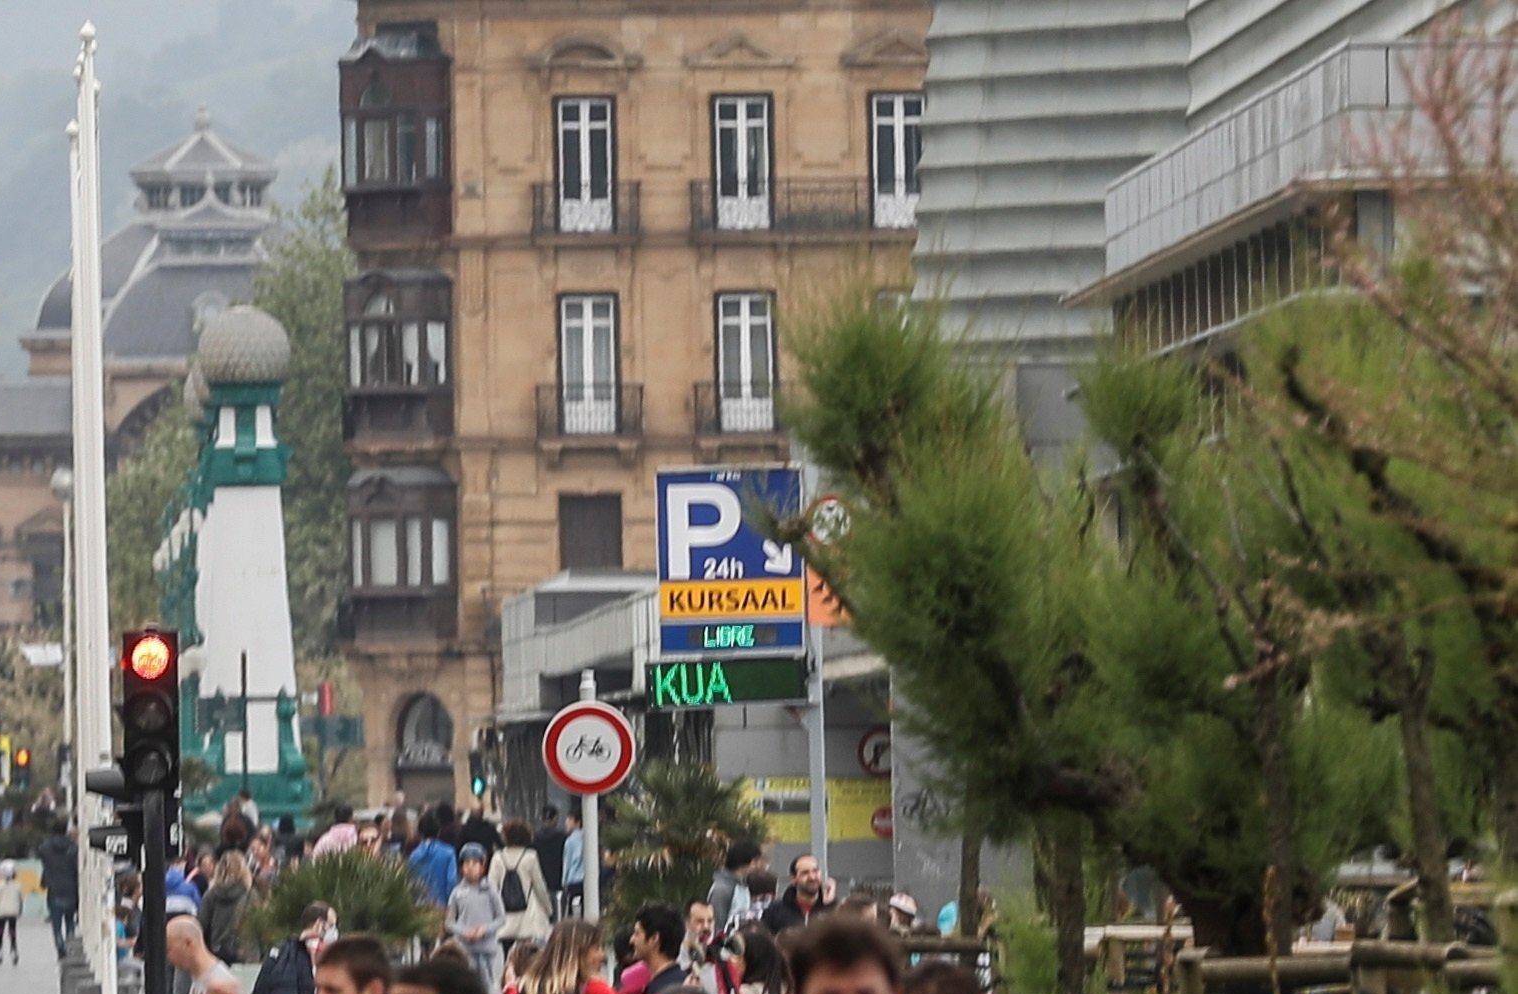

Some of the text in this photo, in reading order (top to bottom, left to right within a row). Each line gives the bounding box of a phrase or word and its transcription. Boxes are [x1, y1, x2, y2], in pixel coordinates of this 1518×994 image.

[666, 482, 741, 581] P
[703, 556, 744, 579] 24h
[669, 587, 795, 613] KURSAAL
[703, 624, 755, 648] LIBRE
[654, 661, 733, 707] KUA
